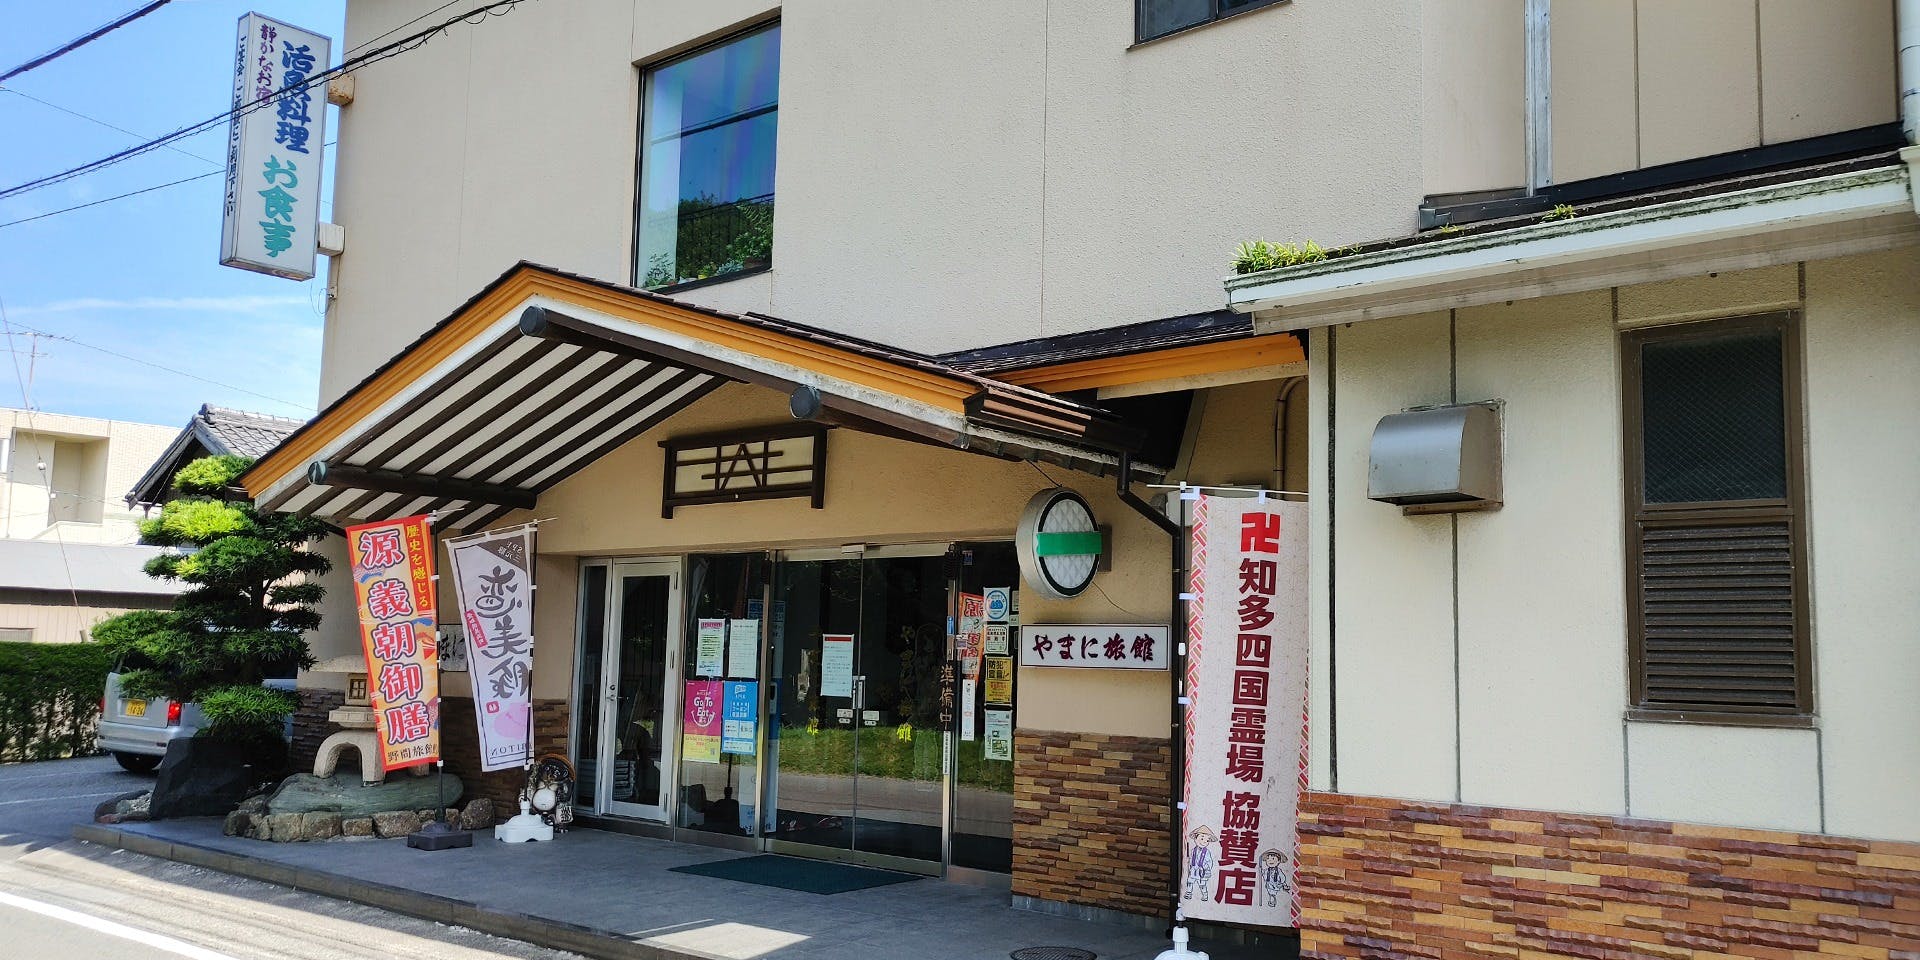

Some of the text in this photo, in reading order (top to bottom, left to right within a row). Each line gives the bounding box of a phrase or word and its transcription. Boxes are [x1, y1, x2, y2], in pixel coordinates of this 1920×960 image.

[255, 23, 278, 105] 静かなお宿
[274, 40, 316, 155] 活魚料理
[257, 154, 299, 258] お食事
[406, 524, 428, 608] 歴史を感じる
[360, 528, 429, 745] 源義朝御膳
[1032, 633, 1155, 662] やまに旅館
[694, 696, 713, 707] Go To
[697, 706, 709, 717] Eat
[939, 664, 954, 731] 準備中
[1214, 790, 1261, 907] 協賛店
